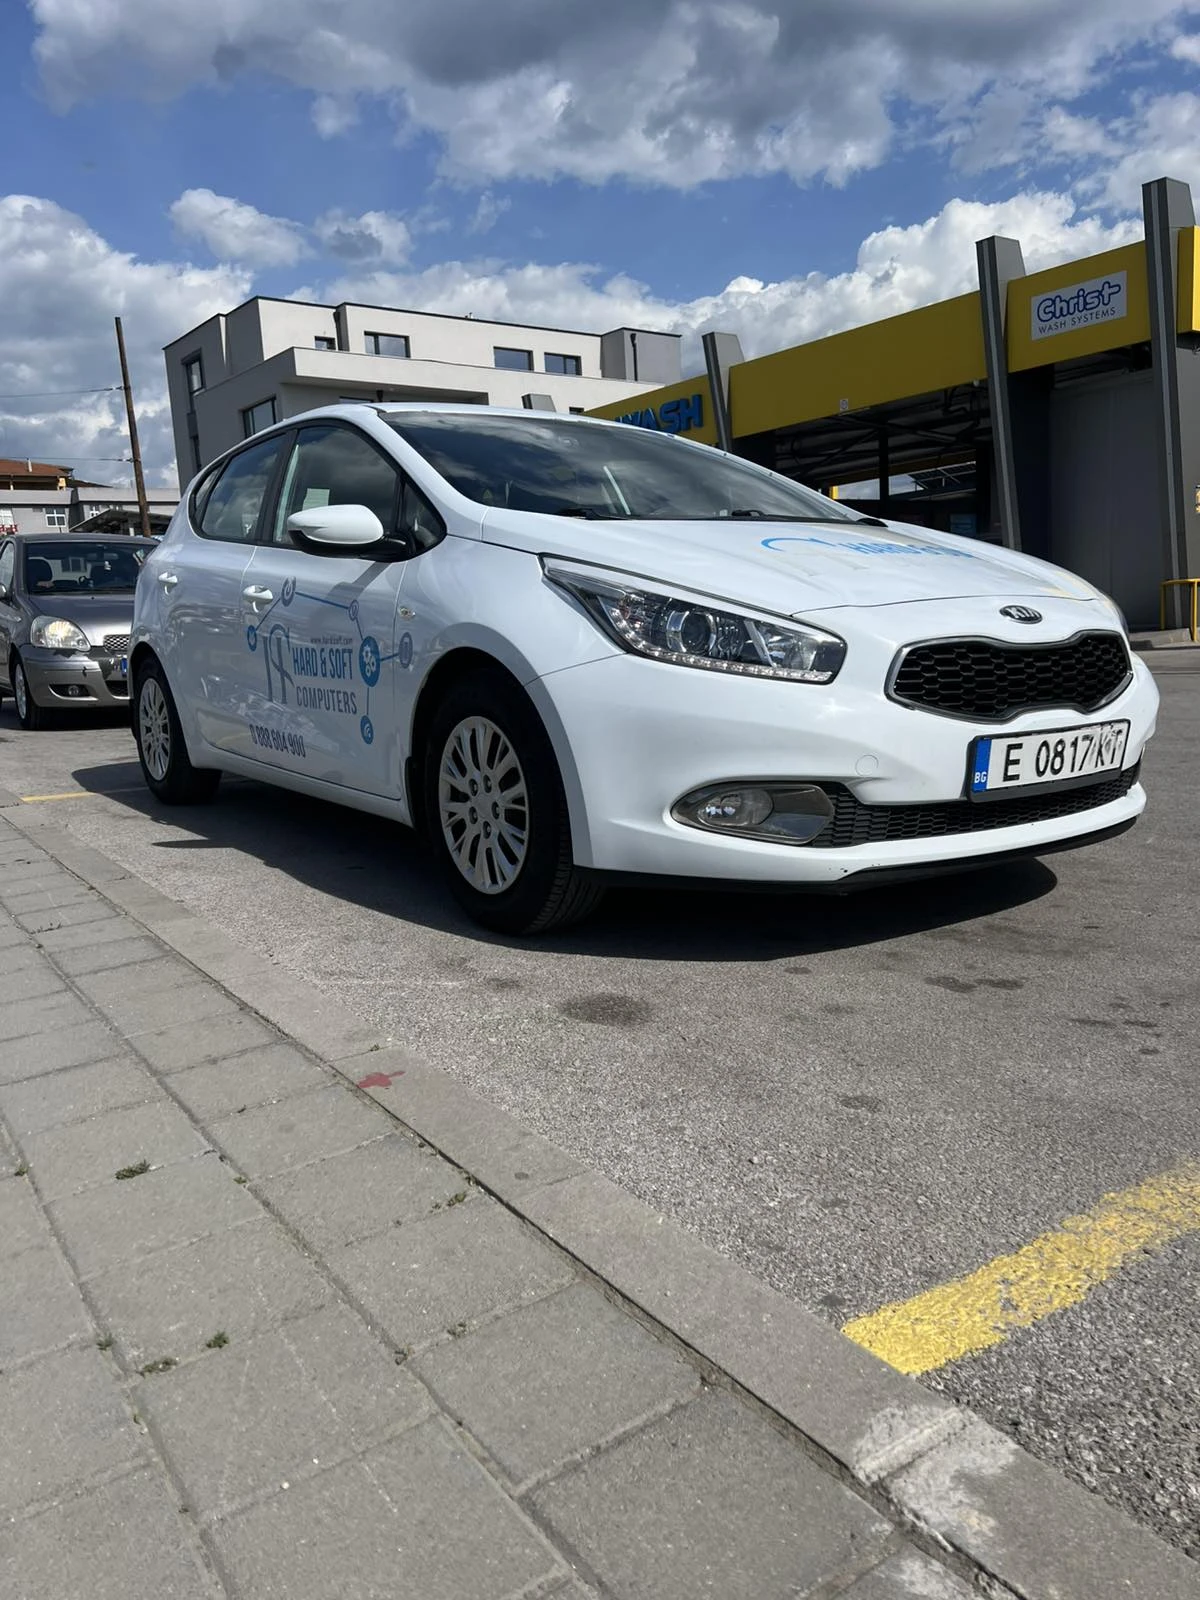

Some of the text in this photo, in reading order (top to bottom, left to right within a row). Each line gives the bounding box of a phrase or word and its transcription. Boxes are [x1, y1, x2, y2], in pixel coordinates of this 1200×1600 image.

[1037, 281, 1121, 322] Christ
[1038, 306, 1117, 335] WASH SYSTEMS
[1003, 605, 1041, 619] KIA
[292, 646, 354, 681] HARD & SOFT
[296, 685, 358, 715] COMPUTERS
[974, 771, 988, 784] BG
[1002, 742, 1024, 783] E
